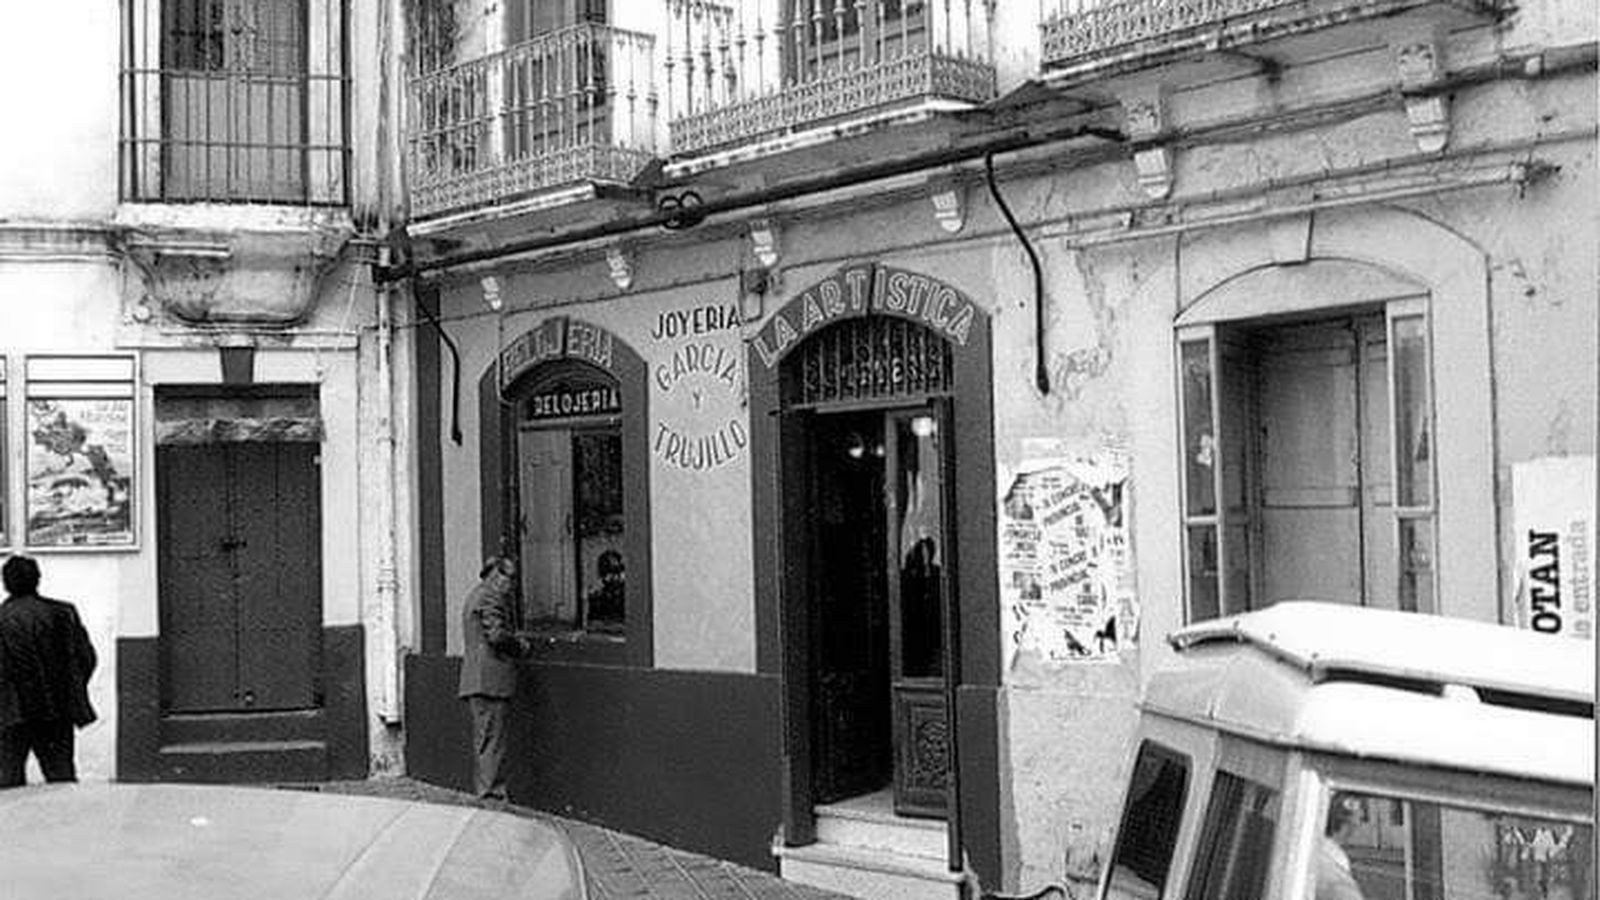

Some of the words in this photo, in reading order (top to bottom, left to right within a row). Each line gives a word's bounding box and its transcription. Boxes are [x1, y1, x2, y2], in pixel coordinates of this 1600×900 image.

[652, 304, 742, 341] JOYERIA
[752, 315, 798, 369] LA
[802, 268, 976, 346] ARTISTICA
[655, 343, 738, 392] GARCIA
[533, 387, 619, 417] RELOJERIA
[692, 389, 705, 409] Y
[653, 418, 748, 472] TRUJILLO
[1529, 529, 1561, 634] OTAN
[1566, 520, 1590, 613] entrada
